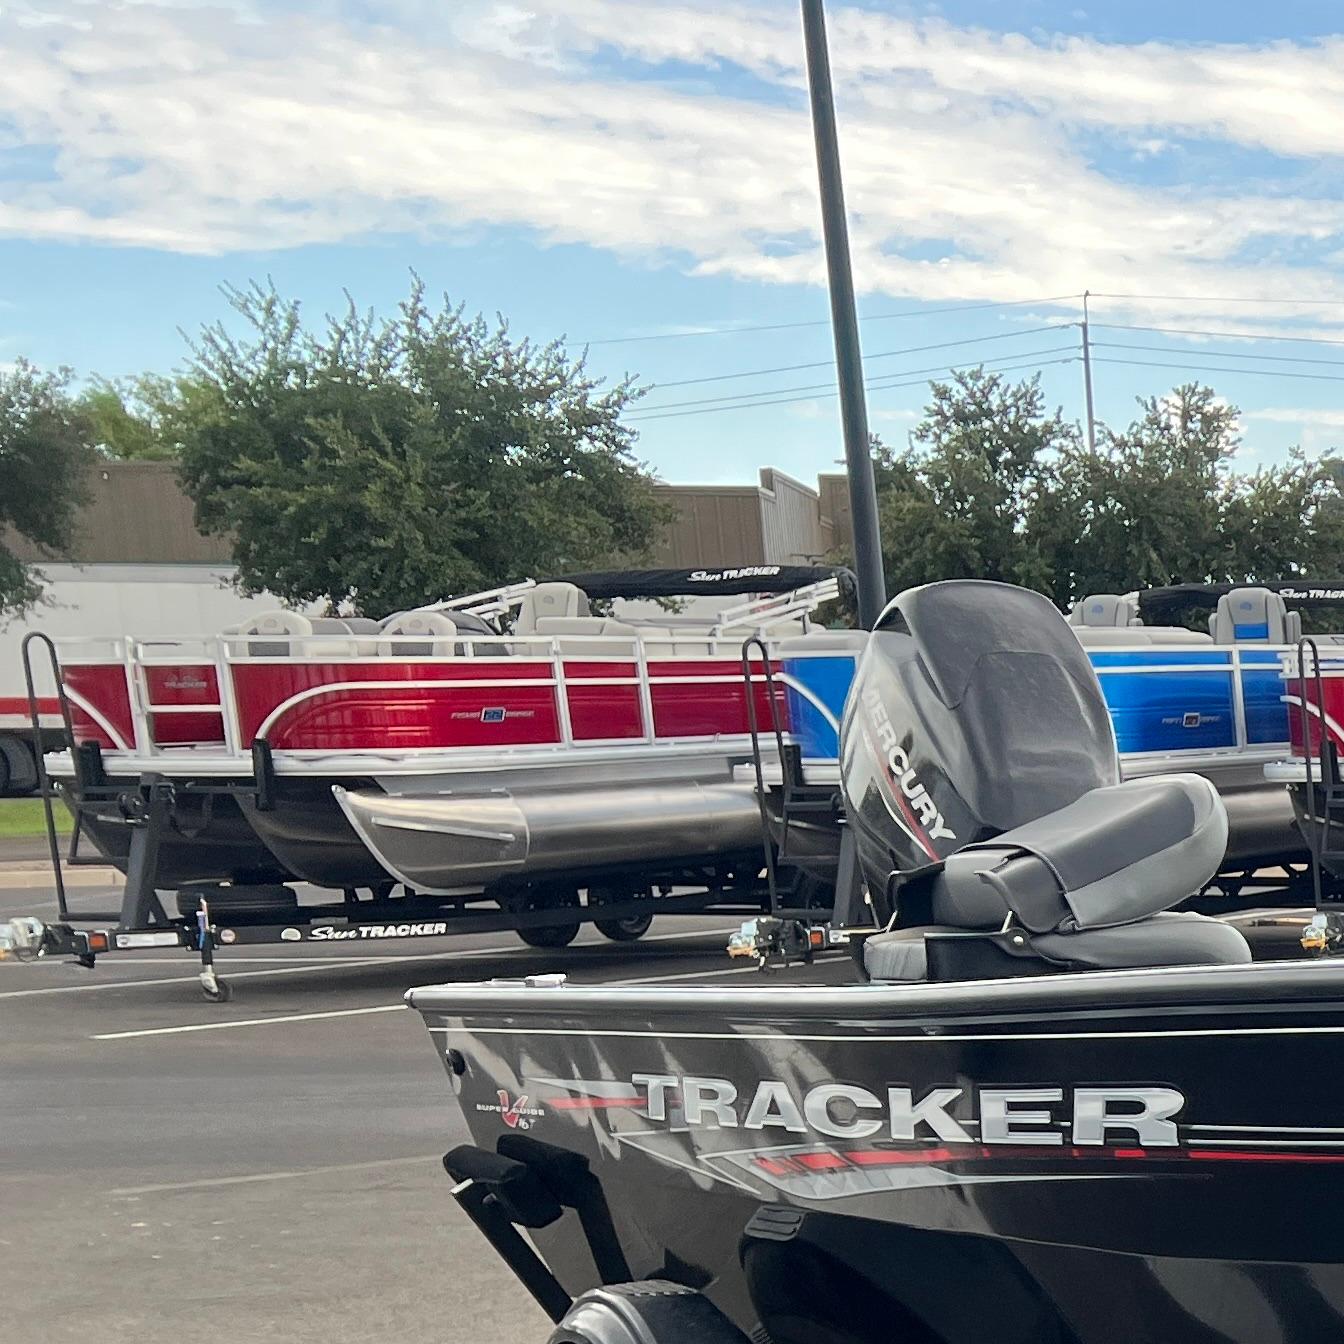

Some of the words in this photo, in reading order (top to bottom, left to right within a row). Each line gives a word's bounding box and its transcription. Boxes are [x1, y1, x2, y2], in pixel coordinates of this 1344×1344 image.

[722, 565, 781, 580] TRACKER
[308, 926, 358, 940] Sun
[359, 922, 447, 938] TRACKER
[631, 1073, 1186, 1148] TRACKER
